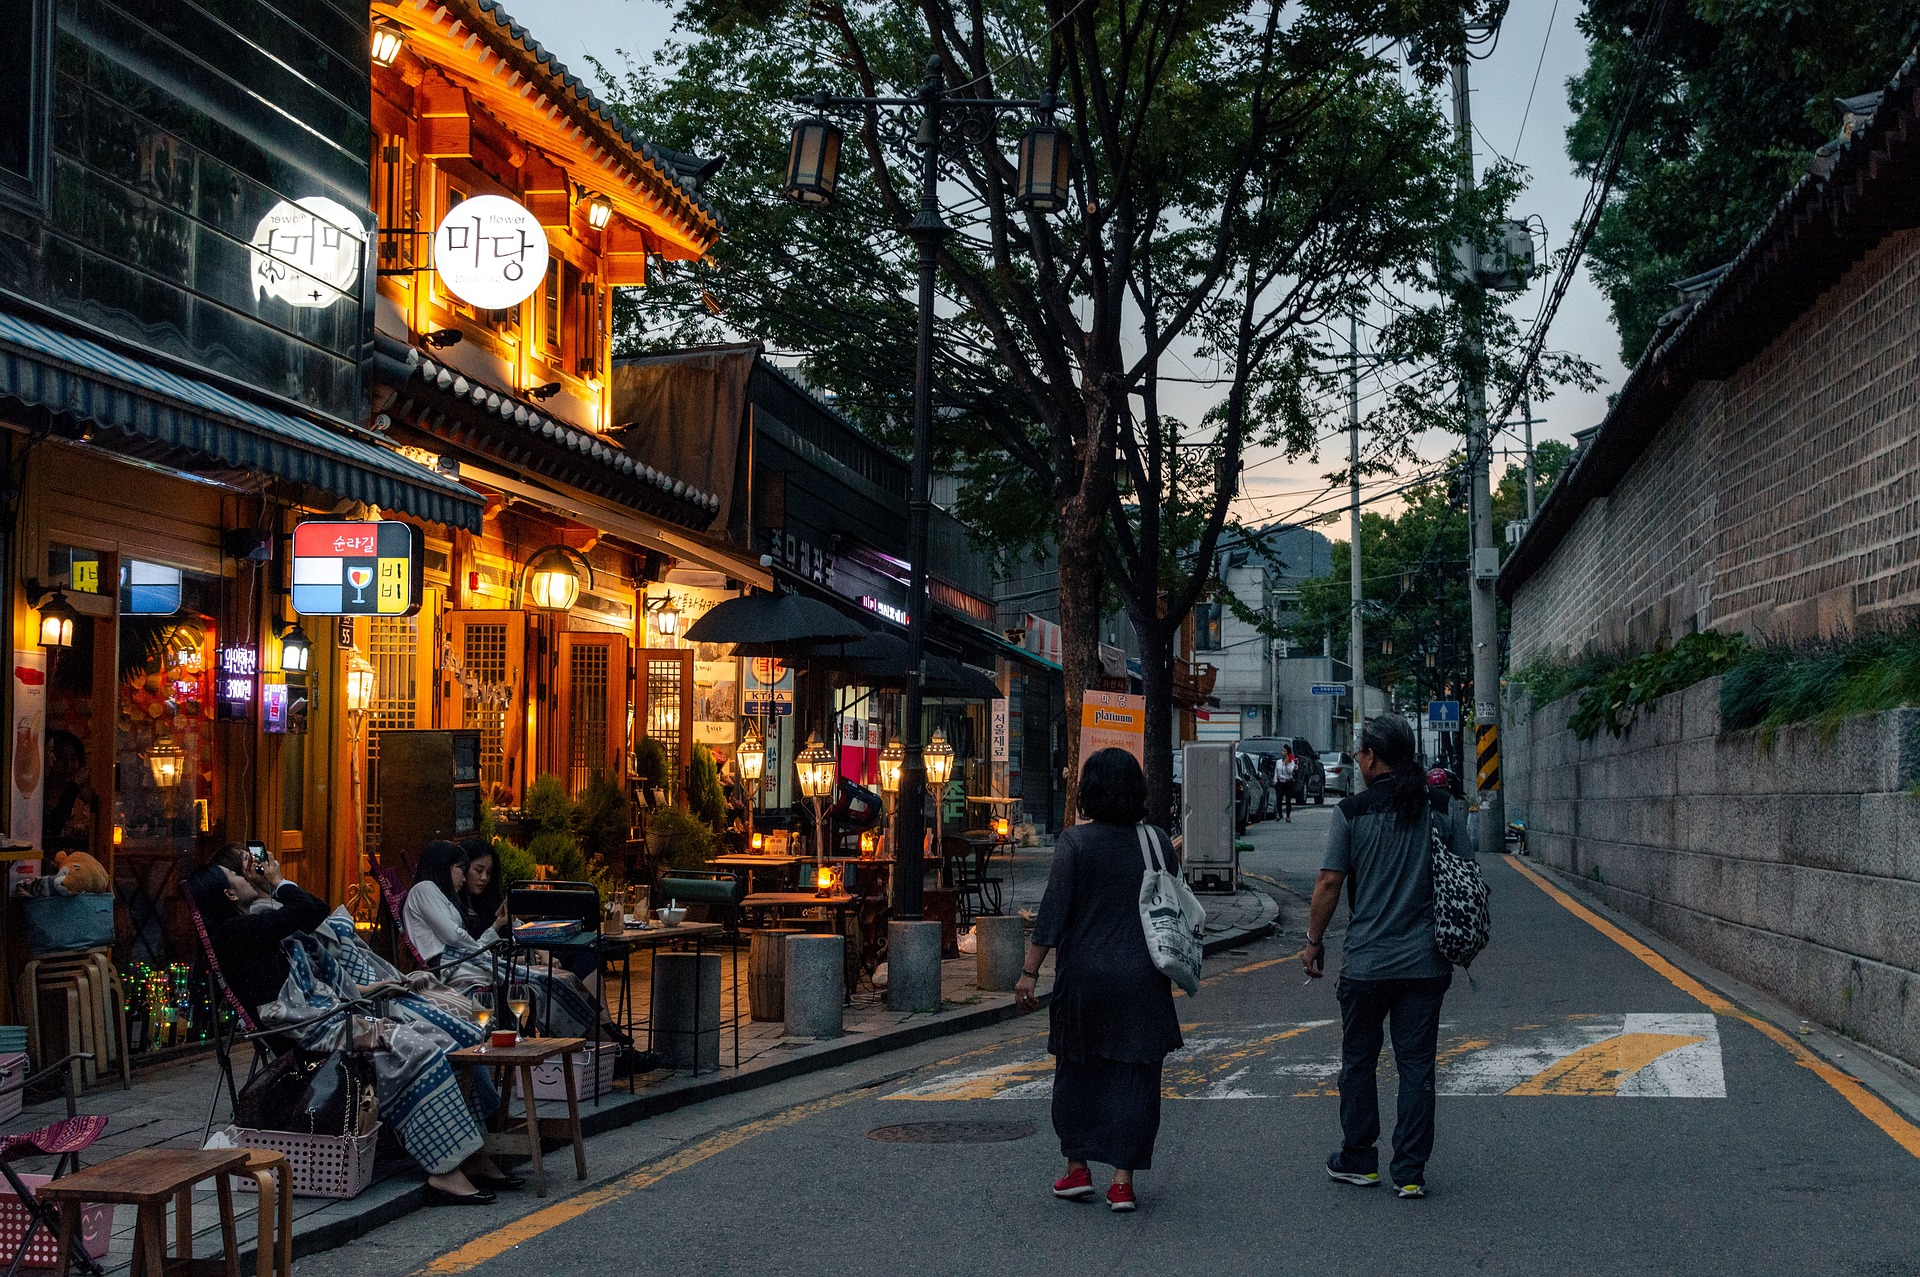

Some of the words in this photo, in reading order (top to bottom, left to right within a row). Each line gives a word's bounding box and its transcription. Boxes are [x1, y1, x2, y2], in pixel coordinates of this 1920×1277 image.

[490, 214, 526, 224] flower
[446, 216, 535, 281] 마당
[333, 536, 374, 553] 순라길
[342, 628, 351, 645] 55
[226, 679, 252, 701] 3900원
[1095, 709, 1133, 725] platinum
[994, 714, 1005, 756] 서울재료
